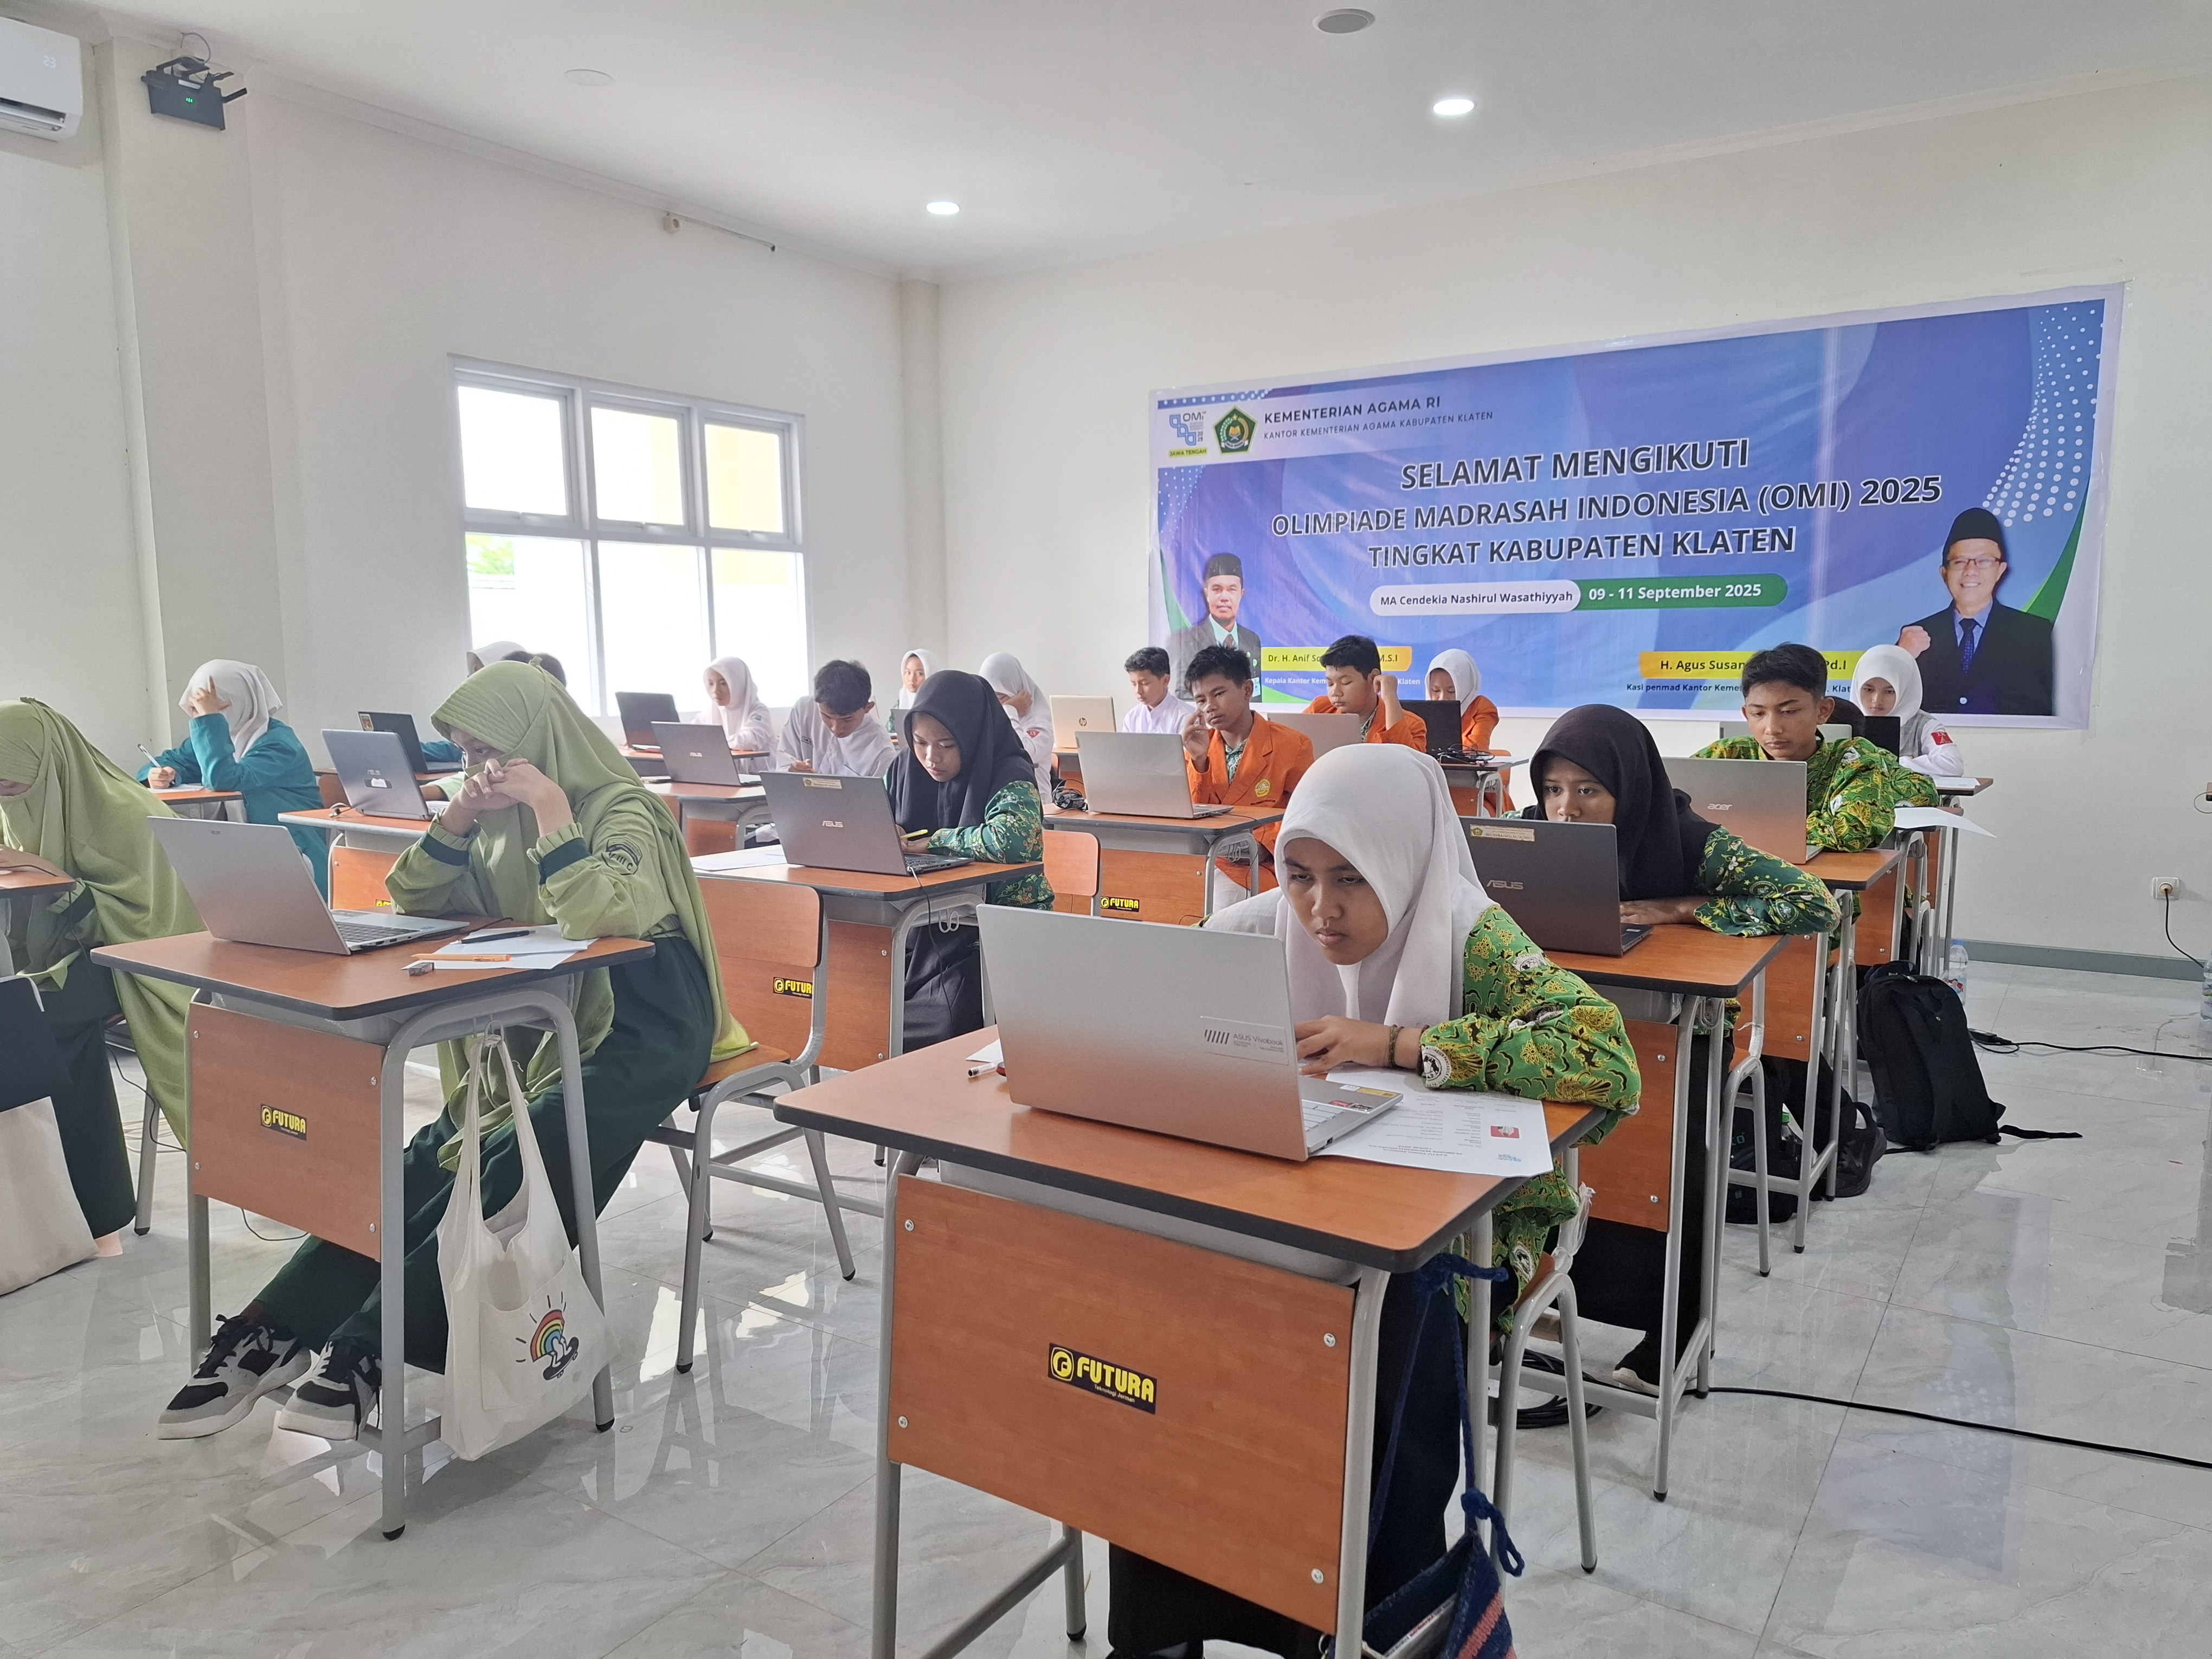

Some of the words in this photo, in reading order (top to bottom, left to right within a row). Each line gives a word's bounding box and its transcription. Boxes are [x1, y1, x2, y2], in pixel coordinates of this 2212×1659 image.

[1264, 404, 1362, 424] KEMENTERIAN
[1367, 398, 1421, 414] AGAMA
[1426, 396, 1441, 408] RI
[1264, 429, 1297, 440] KANTOR
[1301, 424, 1359, 437] KEMENTERIAN
[1363, 421, 1396, 432] AGAMA
[1400, 415, 1454, 428] KABUPATEN
[1458, 411, 1493, 422] KLATEN
[1400, 454, 1543, 491] SELAMAT
[1551, 437, 1750, 480] MENGIKUTI
[1271, 506, 1407, 537] OLIMPIADE
[1414, 497, 1568, 531] MADRASAH
[1577, 486, 1750, 520] INDONESIA
[1757, 481, 1852, 517] (OMI)
[1859, 475, 1943, 506] 2025
[1368, 539, 1482, 569] TINGKAT
[1488, 532, 1662, 564] KABUPATEN
[1671, 525, 1797, 557] KLATEN
[1381, 596, 1397, 606] MA
[1399, 593, 1448, 606] Cendekia
[1450, 592, 1497, 605] Nashirul
[1500, 590, 1573, 606] Wasathiyyah
[1589, 587, 1606, 600] 09
[1618, 587, 1634, 600] 11
[1638, 584, 1722, 603] September
[1725, 583, 1761, 597] 2025
[1293, 654, 1310, 662] Anif
[1661, 660, 1673, 670] H.
[1676, 660, 1705, 672] Agus
[1709, 660, 1745, 670] Susan
[1265, 677, 1287, 685] Kepala
[1645, 684, 1680, 693] penmad
[1715, 684, 1742, 692] Keme
[627, 862, 633, 871] C
[1487, 879, 1524, 890] ASUS
[1110, 897, 1139, 909] FUTURA
[785, 980, 813, 994] FUTUR
[1252, 1036, 1283, 1045] Vivobook
[273, 1110, 306, 1134] FUTURA
[1077, 1356, 1154, 1403] FUTURA
[1095, 1384, 1117, 1397] Teknologi
[1117, 1392, 1135, 1403] Jerman
